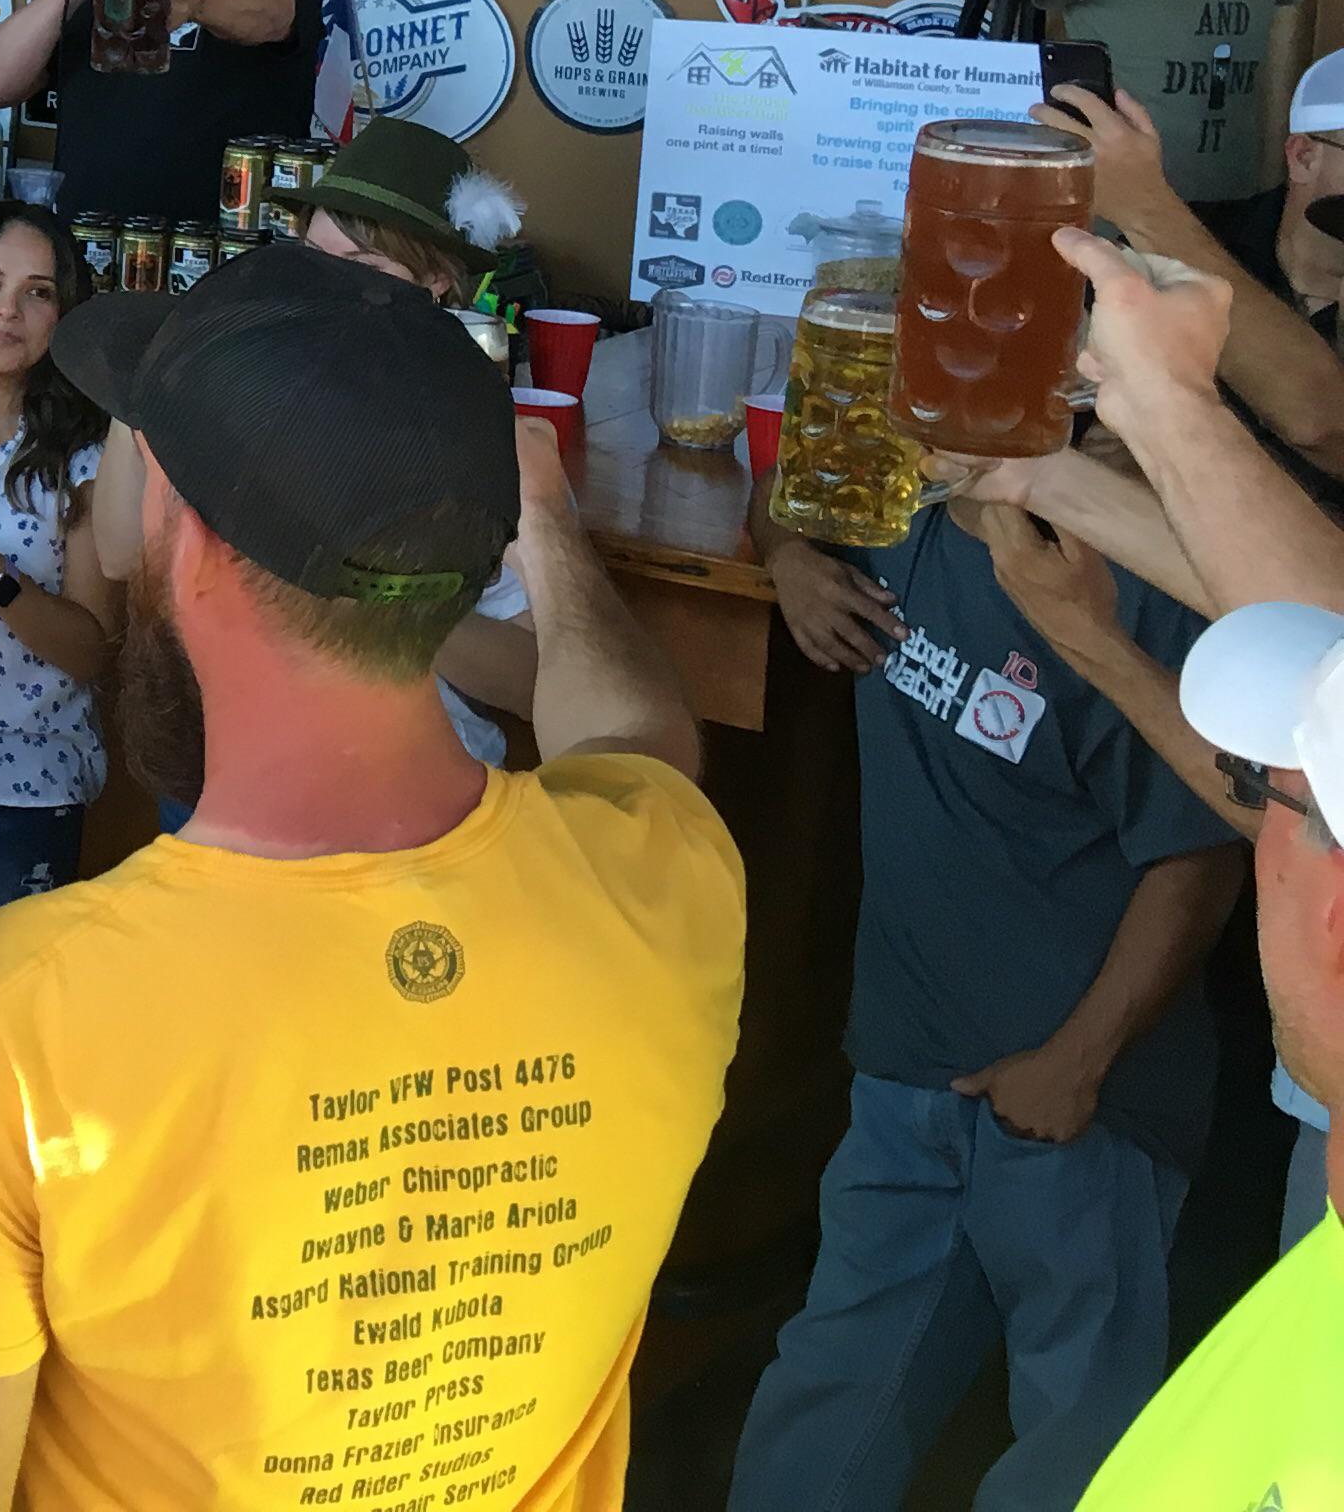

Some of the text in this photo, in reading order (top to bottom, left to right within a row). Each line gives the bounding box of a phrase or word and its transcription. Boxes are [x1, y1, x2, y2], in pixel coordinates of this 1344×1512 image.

[357, 10, 471, 56] ONNET
[1193, 0, 1251, 37] AND
[353, 46, 451, 80] COMPANY
[553, 64, 649, 88] HOPS & GRAIN
[855, 56, 1042, 88] Habitat for Humanit
[577, 85, 627, 100] BREWING
[849, 96, 950, 118] Bringing the
[698, 124, 784, 142] Raising walls
[816, 133, 882, 153] brewing
[877, 118, 914, 134] spirit
[1196, 118, 1226, 154] IT
[666, 138, 784, 157] one pint at time!
[812, 153, 873, 170] to raise
[740, 270, 814, 288] RedHorn
[1001, 649, 1039, 690] 10
[308, 1053, 577, 1123] Taylor VFW Post 4476
[296, 1099, 593, 1173] Remax Associates Group
[323, 1153, 559, 1214] Weber Chiropractic
[300, 1195, 578, 1264] Dwayne & Marie Ariola
[250, 1223, 613, 1321] Asgard National Training Group
[353, 1293, 503, 1345] Ewald Kubota
[305, 1362, 373, 1395] Texas
[384, 1353, 433, 1385] Beer
[346, 1372, 484, 1431] Taylor Press
[263, 1397, 537, 1474] Donna Frazier Insurance
[299, 1484, 342, 1506] Red
[351, 1472, 411, 1500] Rider
[418, 1445, 494, 1483] Studios
[443, 1463, 518, 1507] Service
